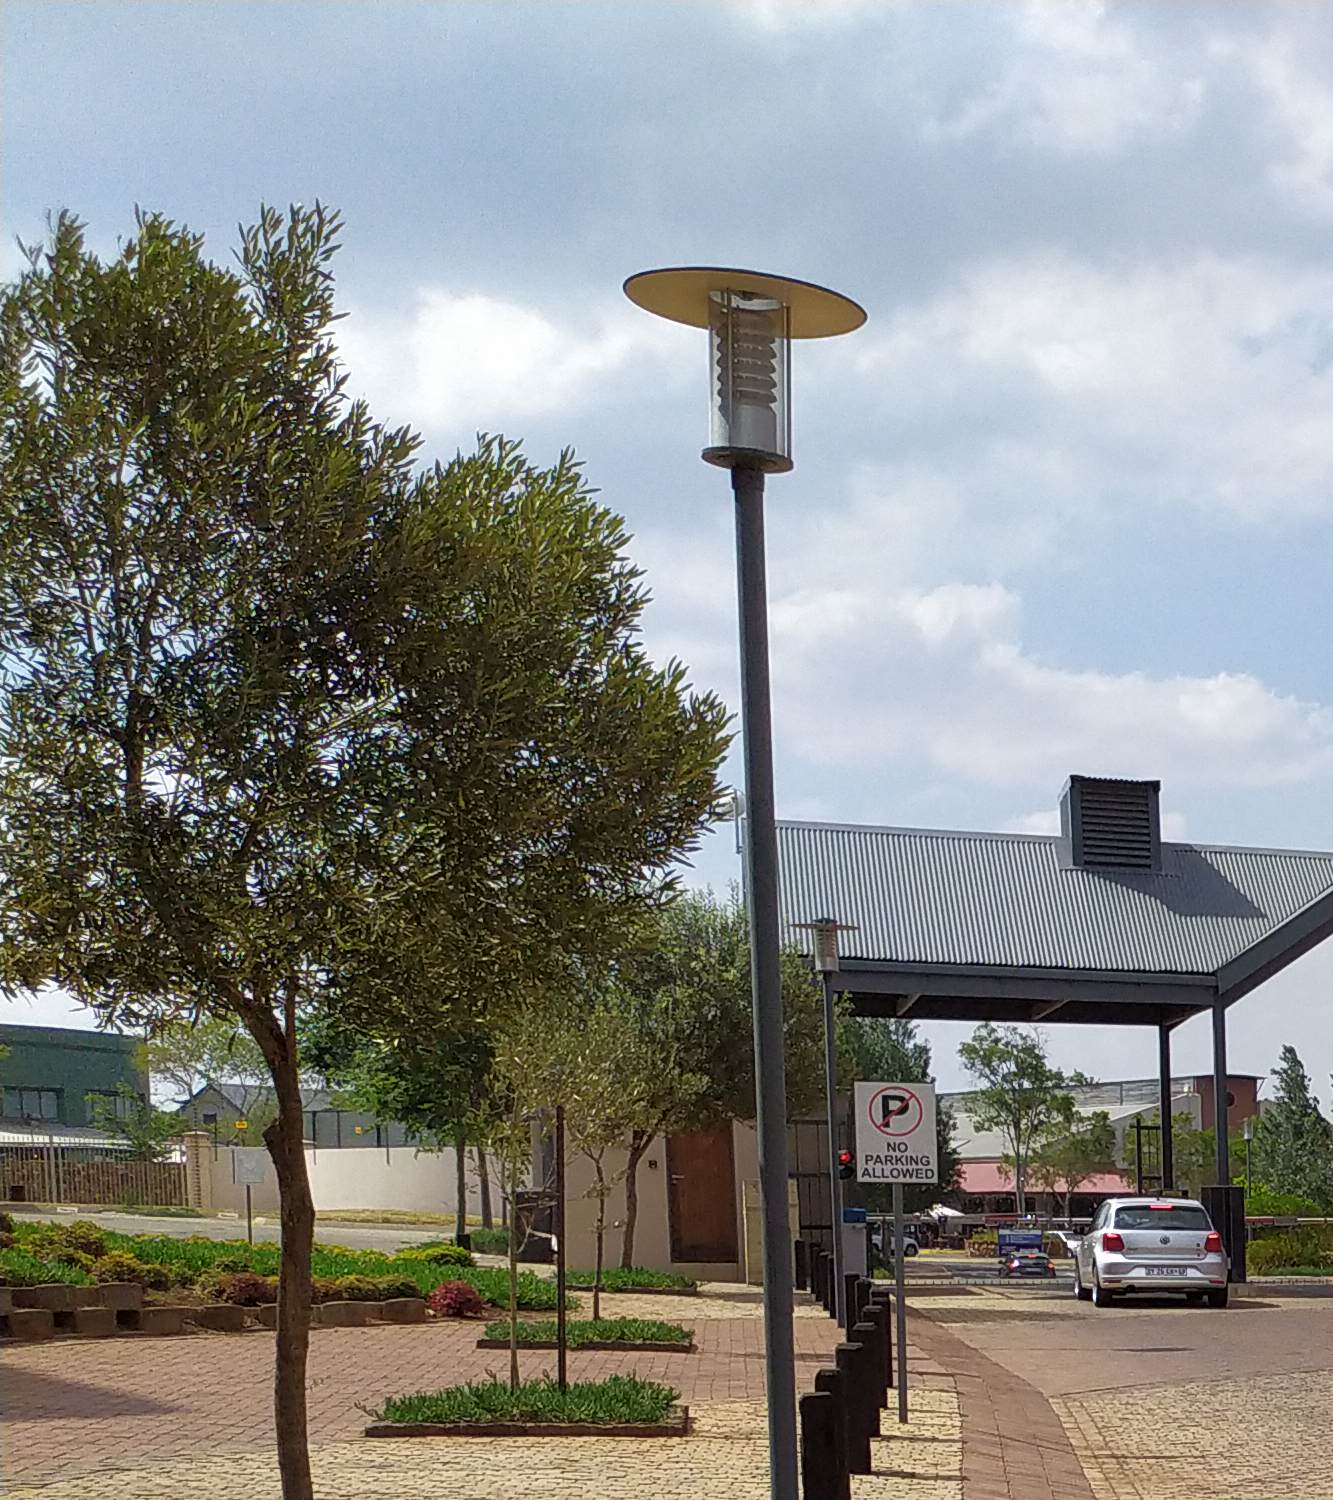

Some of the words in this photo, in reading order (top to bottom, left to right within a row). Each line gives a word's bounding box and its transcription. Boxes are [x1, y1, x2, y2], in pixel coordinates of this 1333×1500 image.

[886, 1142, 909, 1153] NO
[864, 1154, 931, 1167] PARKING
[861, 1167, 935, 1180] ALLOWED
